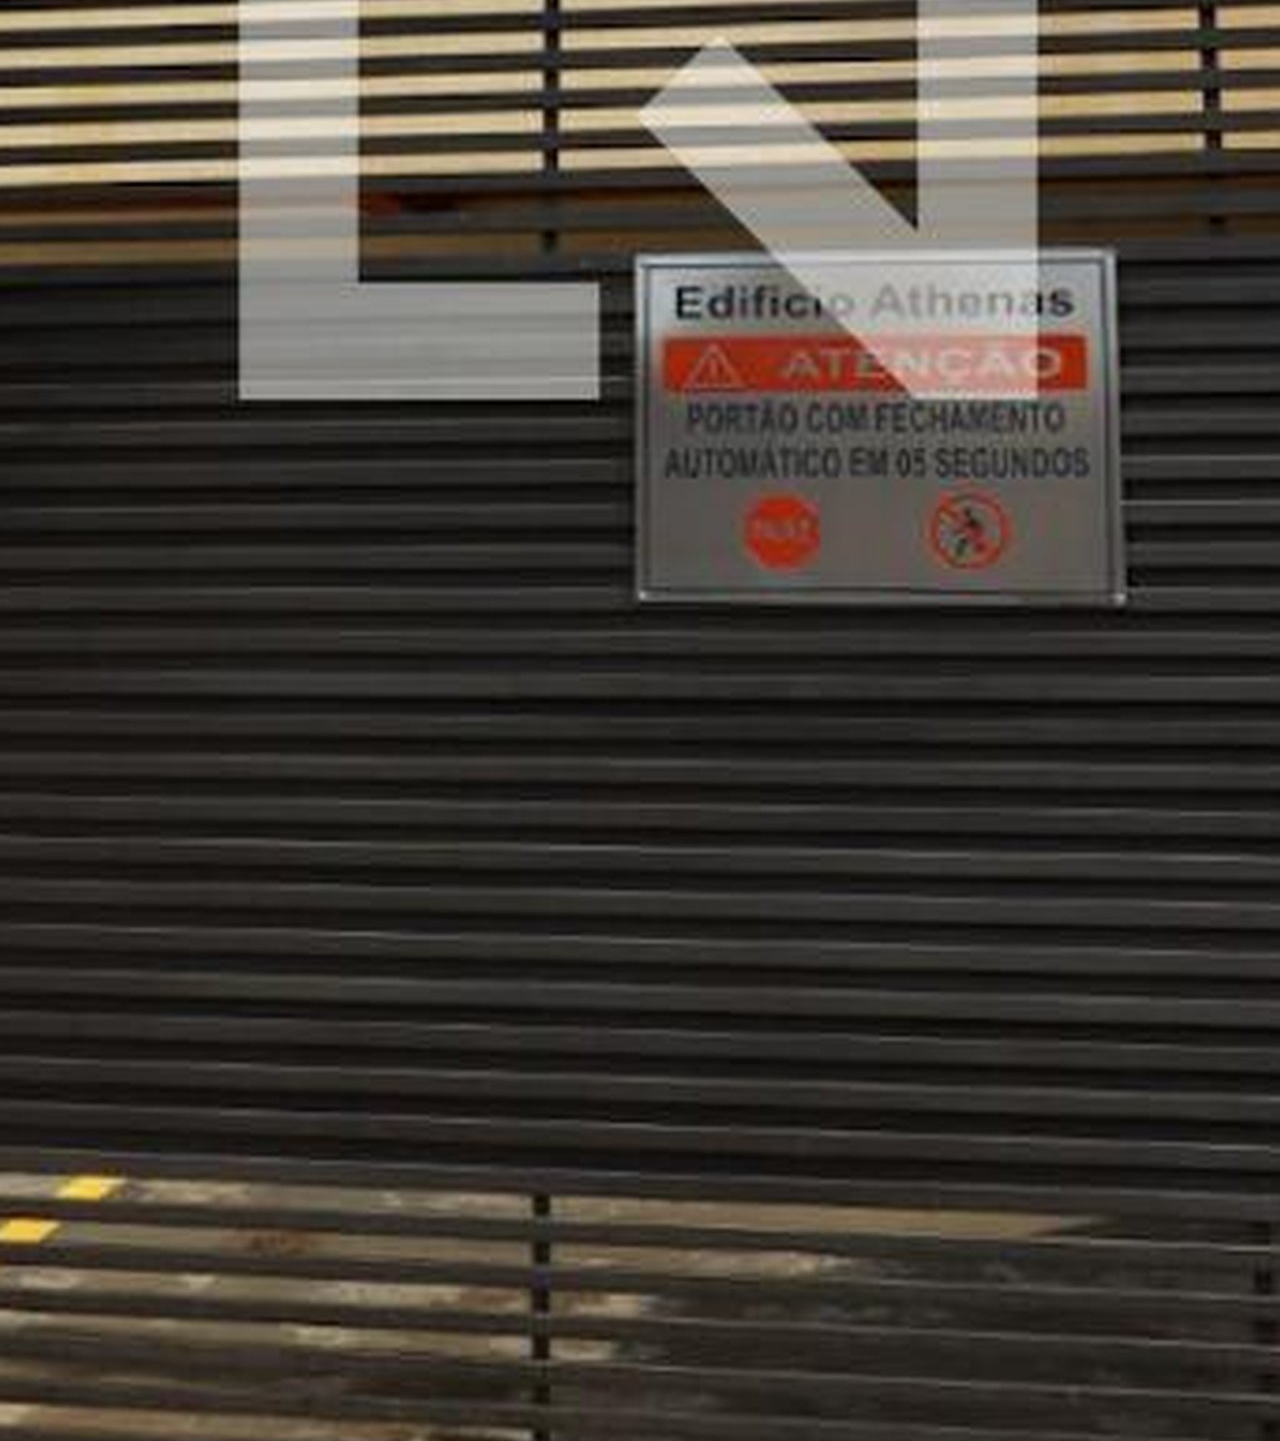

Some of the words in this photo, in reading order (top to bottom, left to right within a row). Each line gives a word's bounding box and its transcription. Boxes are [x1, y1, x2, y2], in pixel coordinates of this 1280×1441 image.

[870, 282, 1075, 321] Athenas
[687, 399, 799, 434] PORTÃO
[807, 402, 870, 433] COM
[875, 400, 1066, 433] FECHAMENTO
[849, 447, 888, 479] EM
[895, 447, 928, 479] 05
[934, 446, 1091, 479] SEGUNDOS
